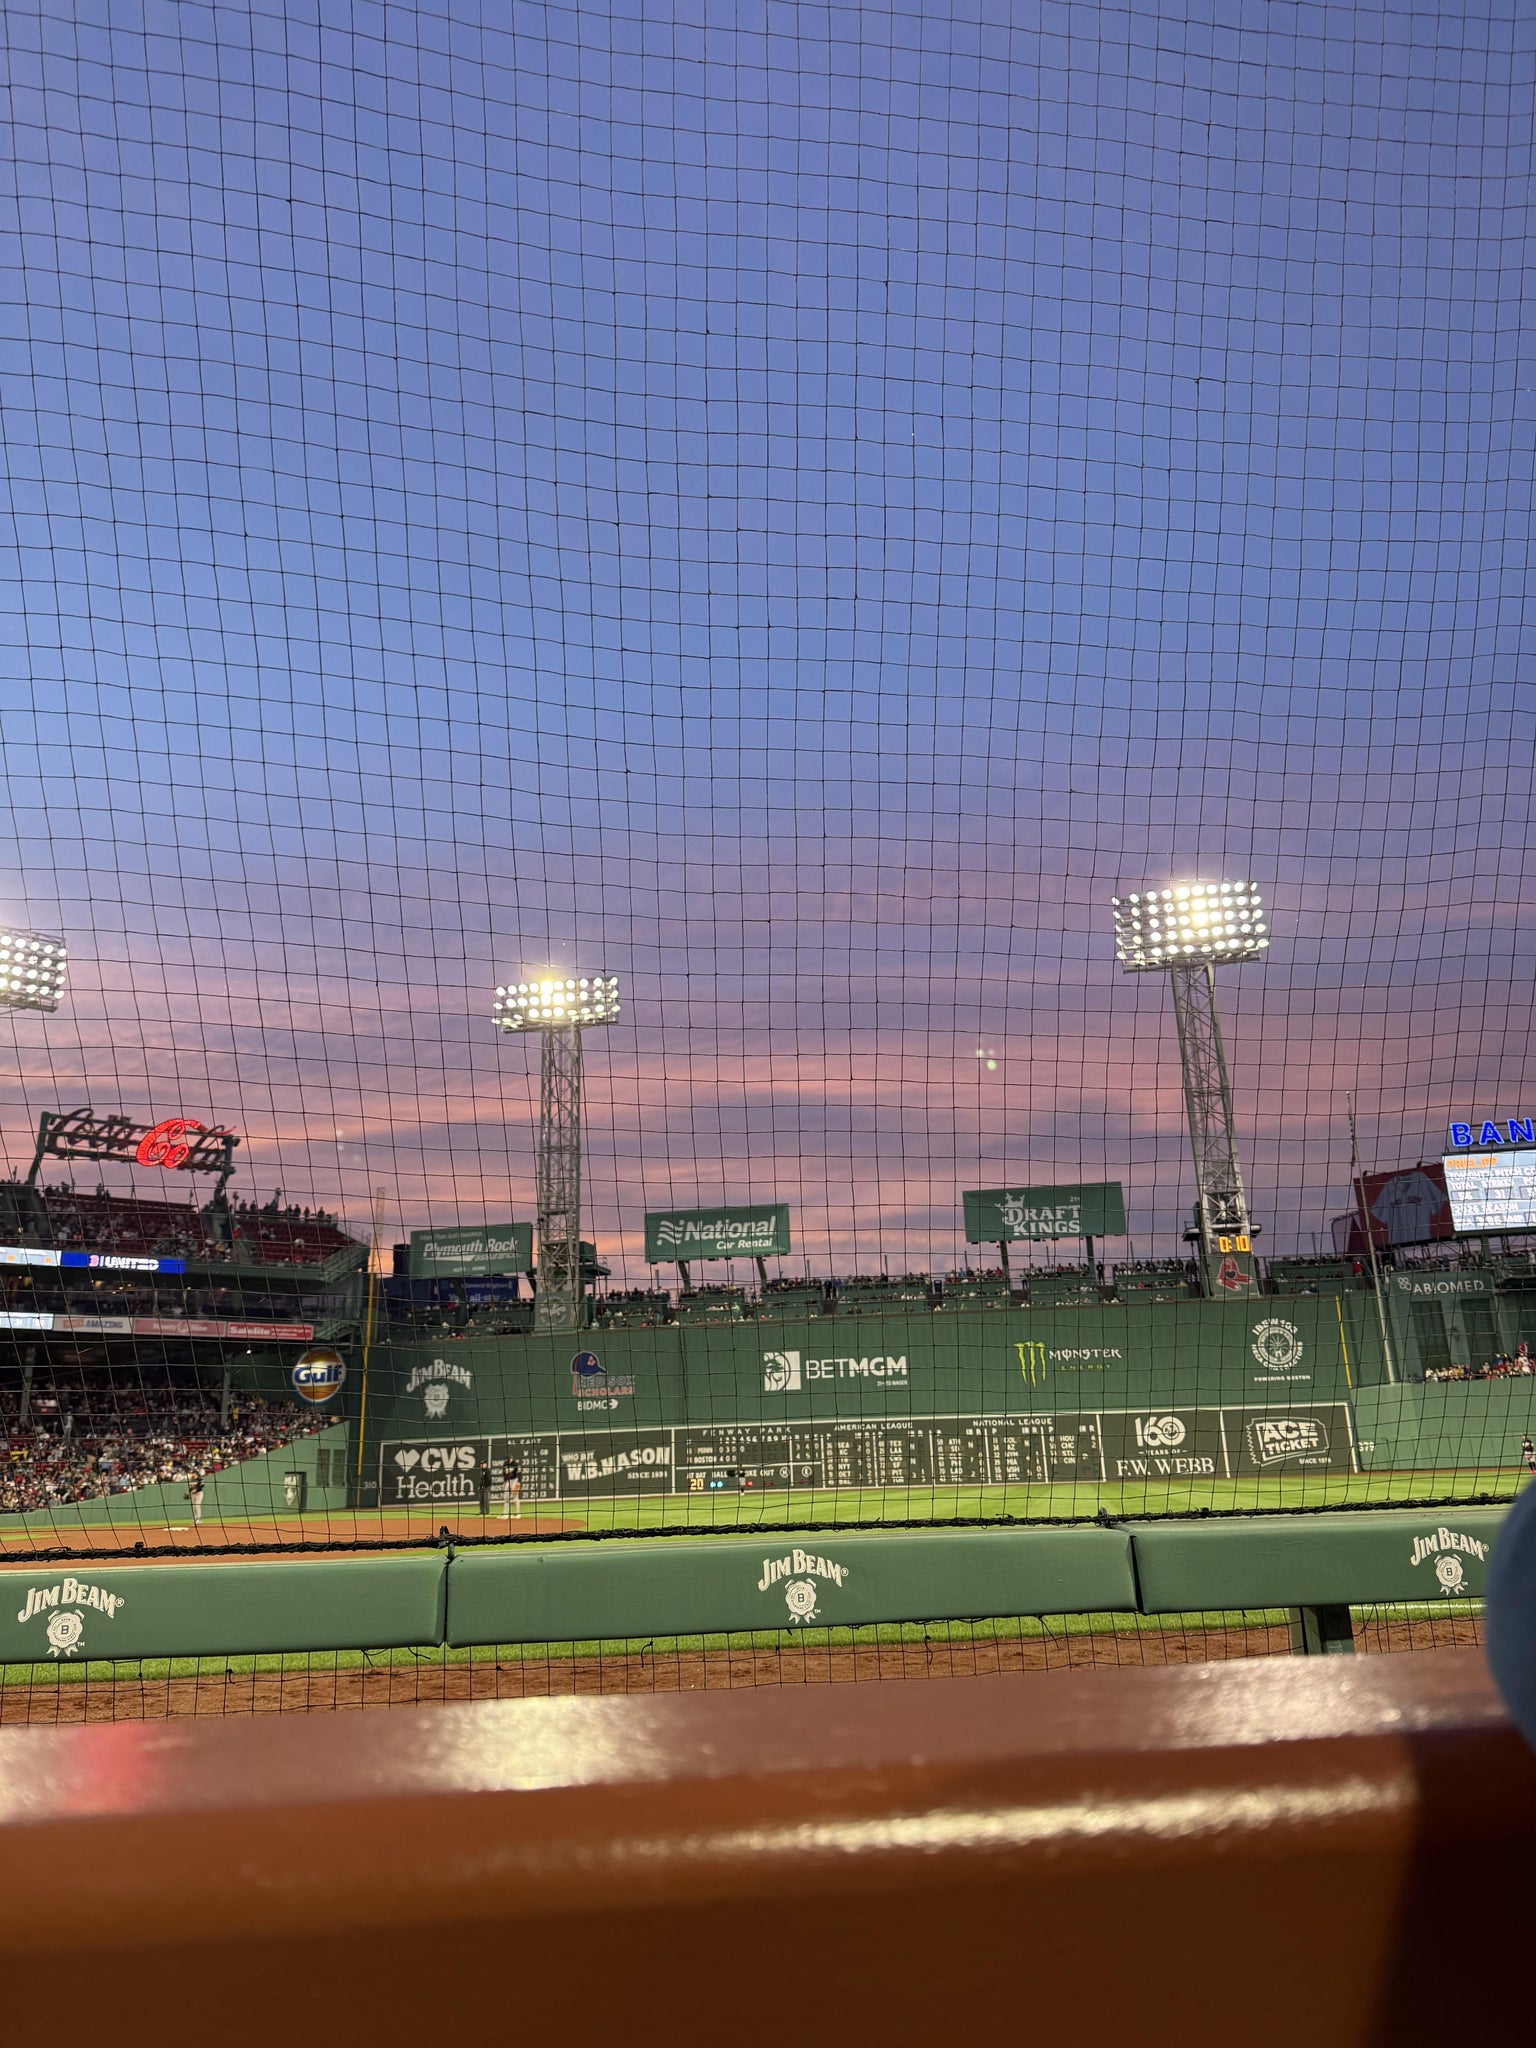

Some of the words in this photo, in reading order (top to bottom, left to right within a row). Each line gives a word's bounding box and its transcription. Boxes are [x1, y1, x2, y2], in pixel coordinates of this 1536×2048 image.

[1449, 1118, 1536, 1146] BAN
[1001, 1204, 1081, 1225] DRAFT
[684, 1216, 777, 1241] National
[1013, 1220, 1081, 1236] KINGS
[423, 1239, 483, 1257] Plymouth
[486, 1237, 518, 1252] Rock
[716, 1241, 735, 1250] Car
[738, 1238, 773, 1249] Rental
[1218, 1234, 1250, 1252] 0:10
[104, 1256, 160, 1271] UNITED
[1413, 1280, 1485, 1295] ABIOMED
[1048, 1348, 1122, 1361] MONSTER
[294, 1364, 343, 1385] Gulf
[406, 1365, 433, 1392] JIM
[434, 1359, 473, 1390] BEAM
[805, 1356, 907, 1379] BETMGM
[577, 1400, 608, 1410] BIDMC
[702, 1428, 750, 1436] FENWAY
[834, 1423, 877, 1431] AMERICAN
[973, 1419, 1015, 1427] NATIONAL
[1018, 1418, 1052, 1426] LEAGUE
[1135, 1416, 1186, 1446] 160
[1263, 1421, 1318, 1442] ACE
[1265, 1438, 1318, 1454] TICKET
[421, 1446, 476, 1472] CVS
[1116, 1459, 1151, 1476] F.W.
[1154, 1457, 1214, 1475] WEBB
[627, 1471, 650, 1479] SINCE
[396, 1474, 476, 1498] Health
[1410, 1534, 1439, 1566] JIM
[757, 1556, 791, 1591] JIM
[17, 1585, 60, 1623] JIM
